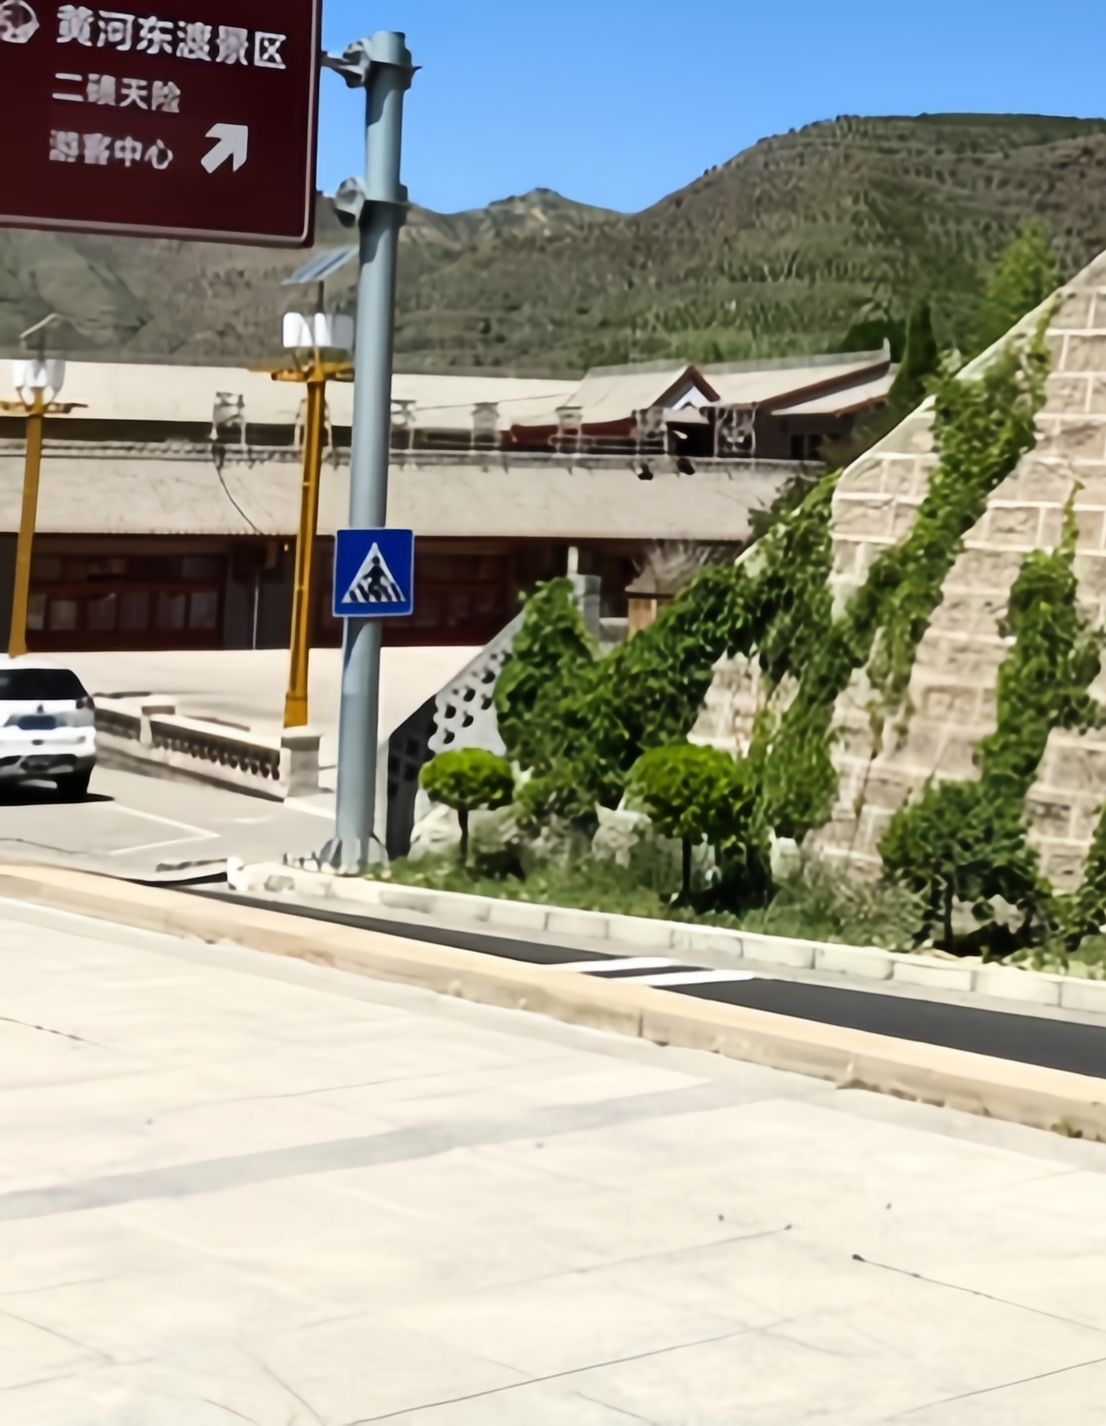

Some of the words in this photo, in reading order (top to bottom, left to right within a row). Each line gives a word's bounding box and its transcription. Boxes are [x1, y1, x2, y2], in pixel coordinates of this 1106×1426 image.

[56, 4, 287, 69] 黄河东渡景区
